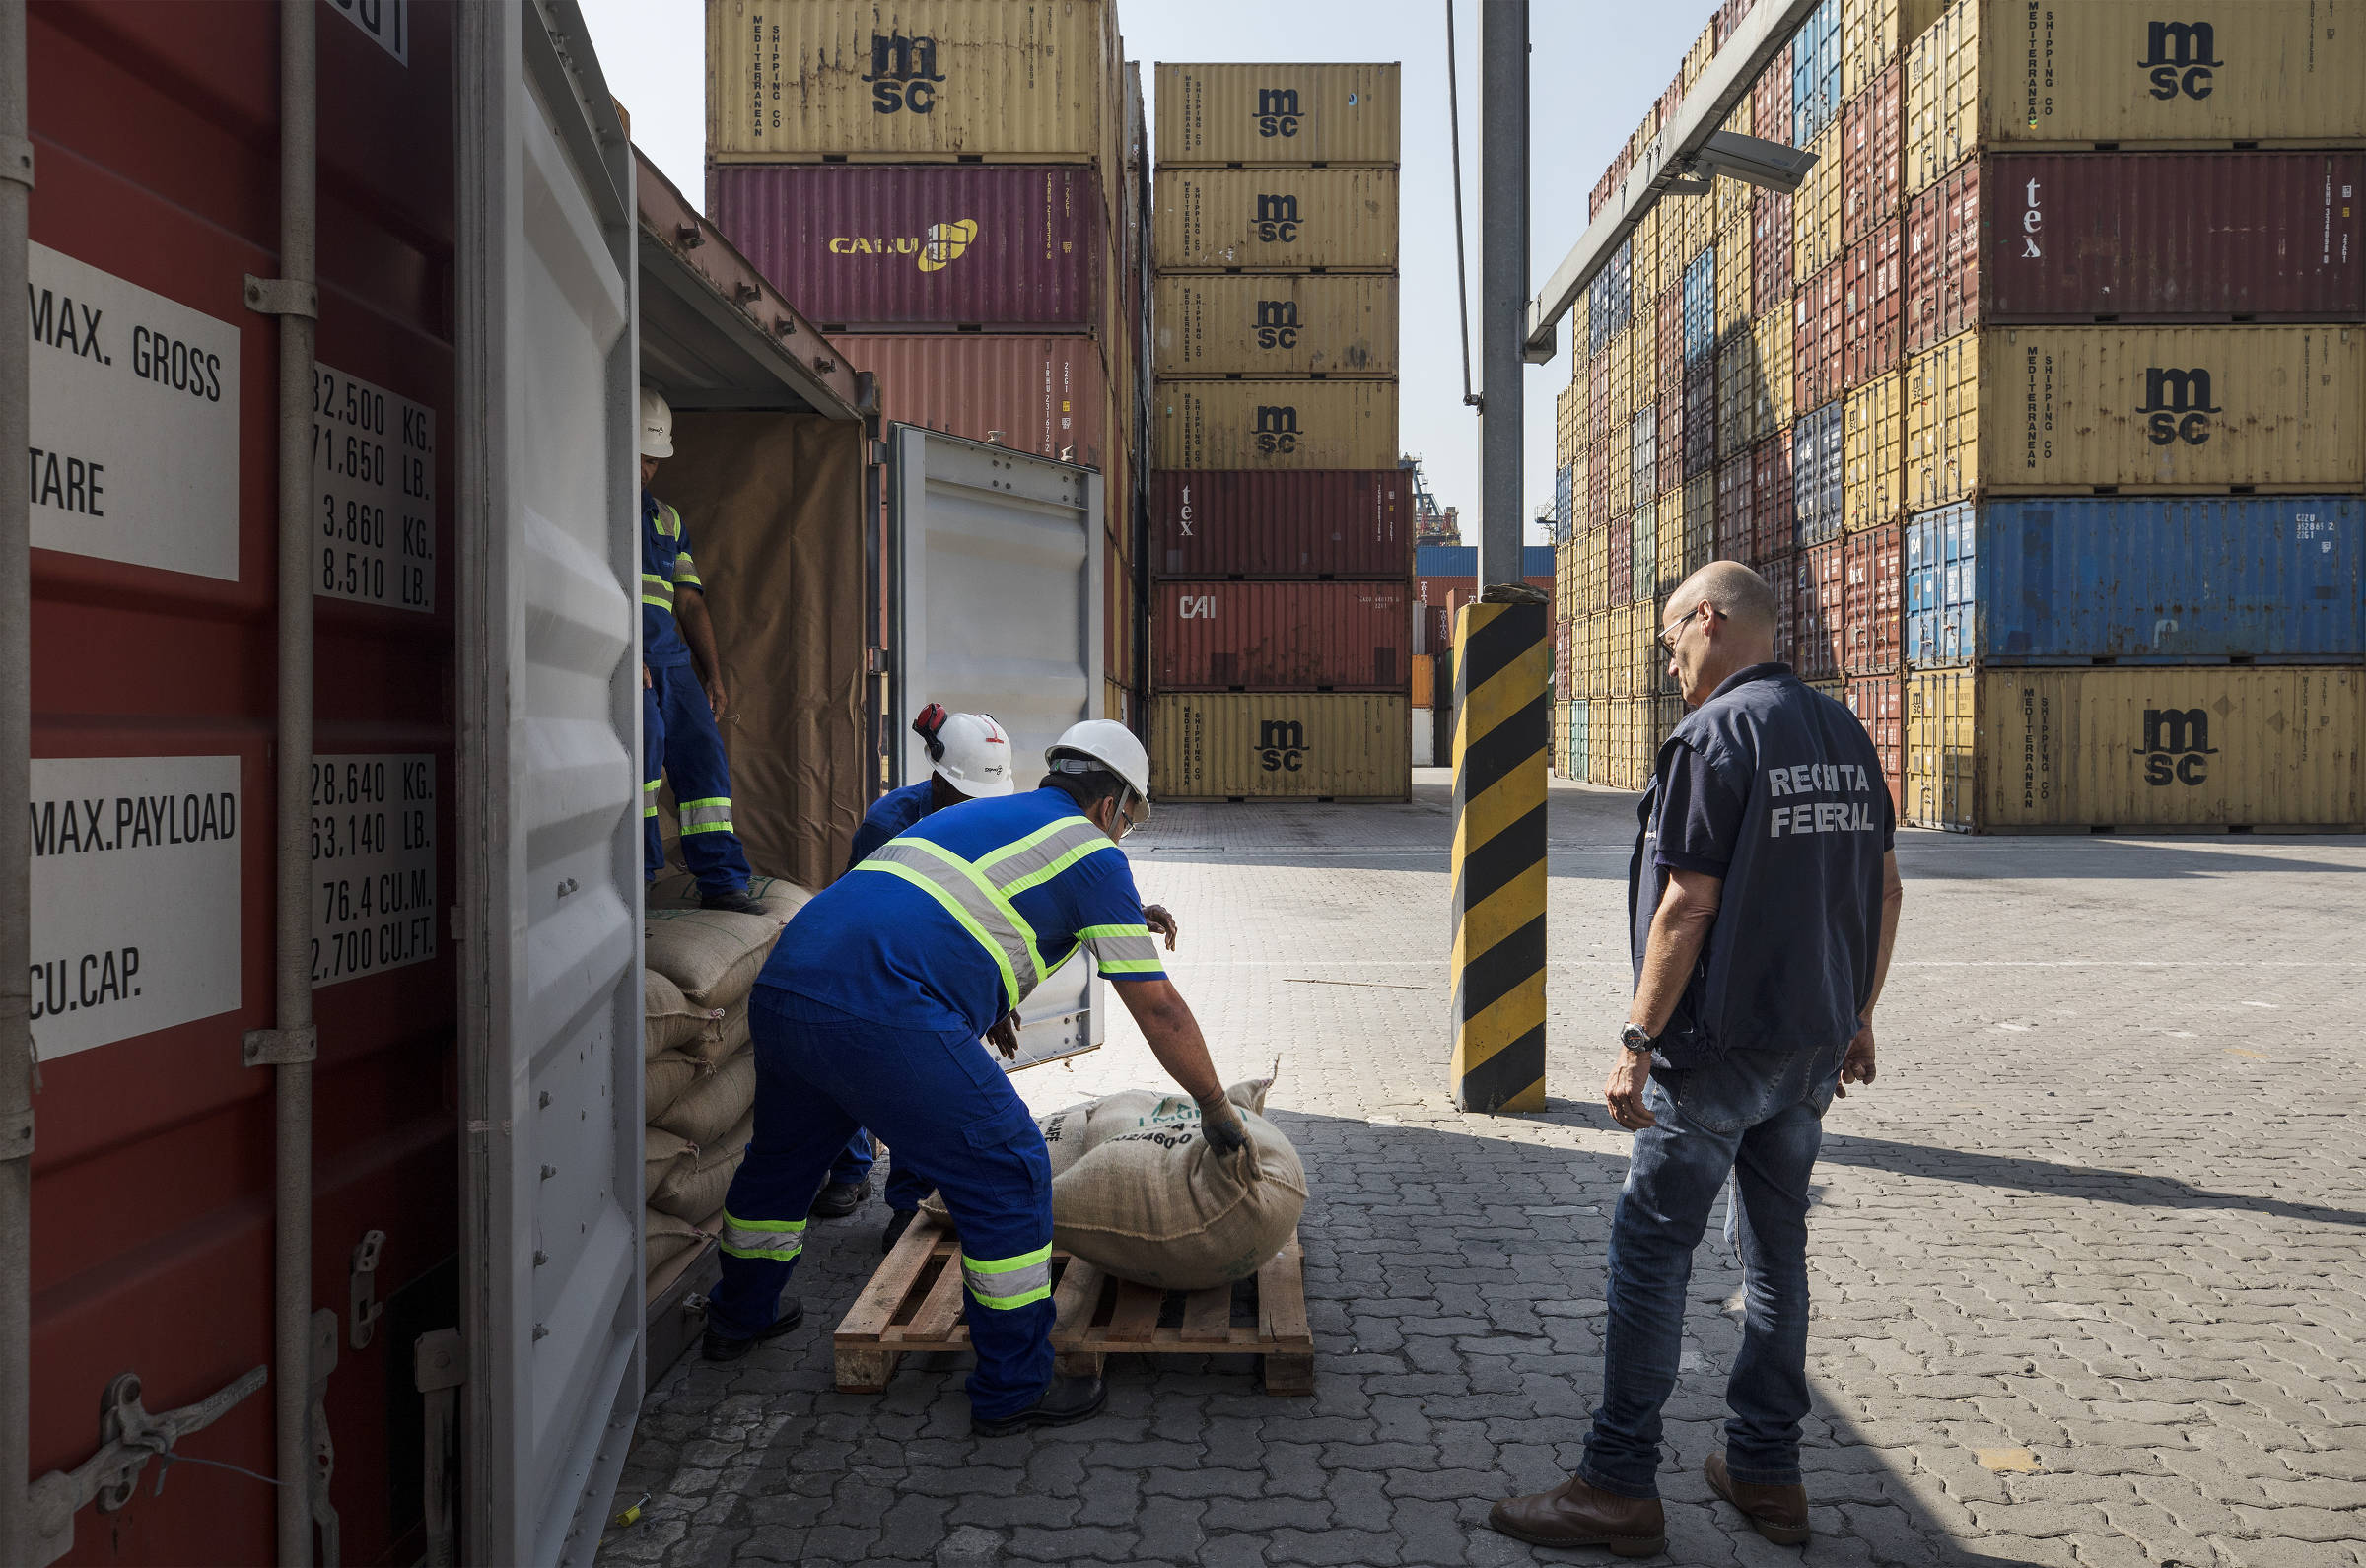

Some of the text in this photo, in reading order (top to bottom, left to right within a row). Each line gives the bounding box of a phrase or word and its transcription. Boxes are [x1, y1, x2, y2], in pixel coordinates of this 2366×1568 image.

[753, 15, 762, 137] MEDITERRANEAN
[772, 26, 781, 128] SHIPPING CO
[2045, 98, 2053, 115] CO
[1195, 134, 1201, 146] CO
[1195, 239, 1200, 251] CO
[133, 325, 221, 402] GROSS
[1196, 346, 1202, 357] CO
[403, 405, 432, 453] KG.
[2027, 346, 2038, 468] MEDITERRANEAN
[2044, 355, 2053, 459] SHIPPING CO
[29, 447, 104, 516] TARE
[403, 454, 430, 501] LB.
[1195, 450, 1201, 462] CO
[323, 494, 432, 560] 3,860 KG.
[1180, 485, 1194, 535] tex
[323, 547, 429, 606] 8,510 LB.
[1179, 596, 1216, 619] CAI
[1195, 768, 1201, 780] CO
[2024, 688, 2035, 808] MEDITERRANEAN
[2040, 697, 2049, 800] SHIPPING CO
[312, 762, 433, 806] 28,640 KG.
[30, 792, 235, 857] MAX.PAYLOAD
[404, 810, 430, 850] LB.
[323, 869, 432, 924] 76.4 CU.M.
[379, 917, 433, 965] CU.FT.
[30, 946, 141, 1020] CU.CAP.
